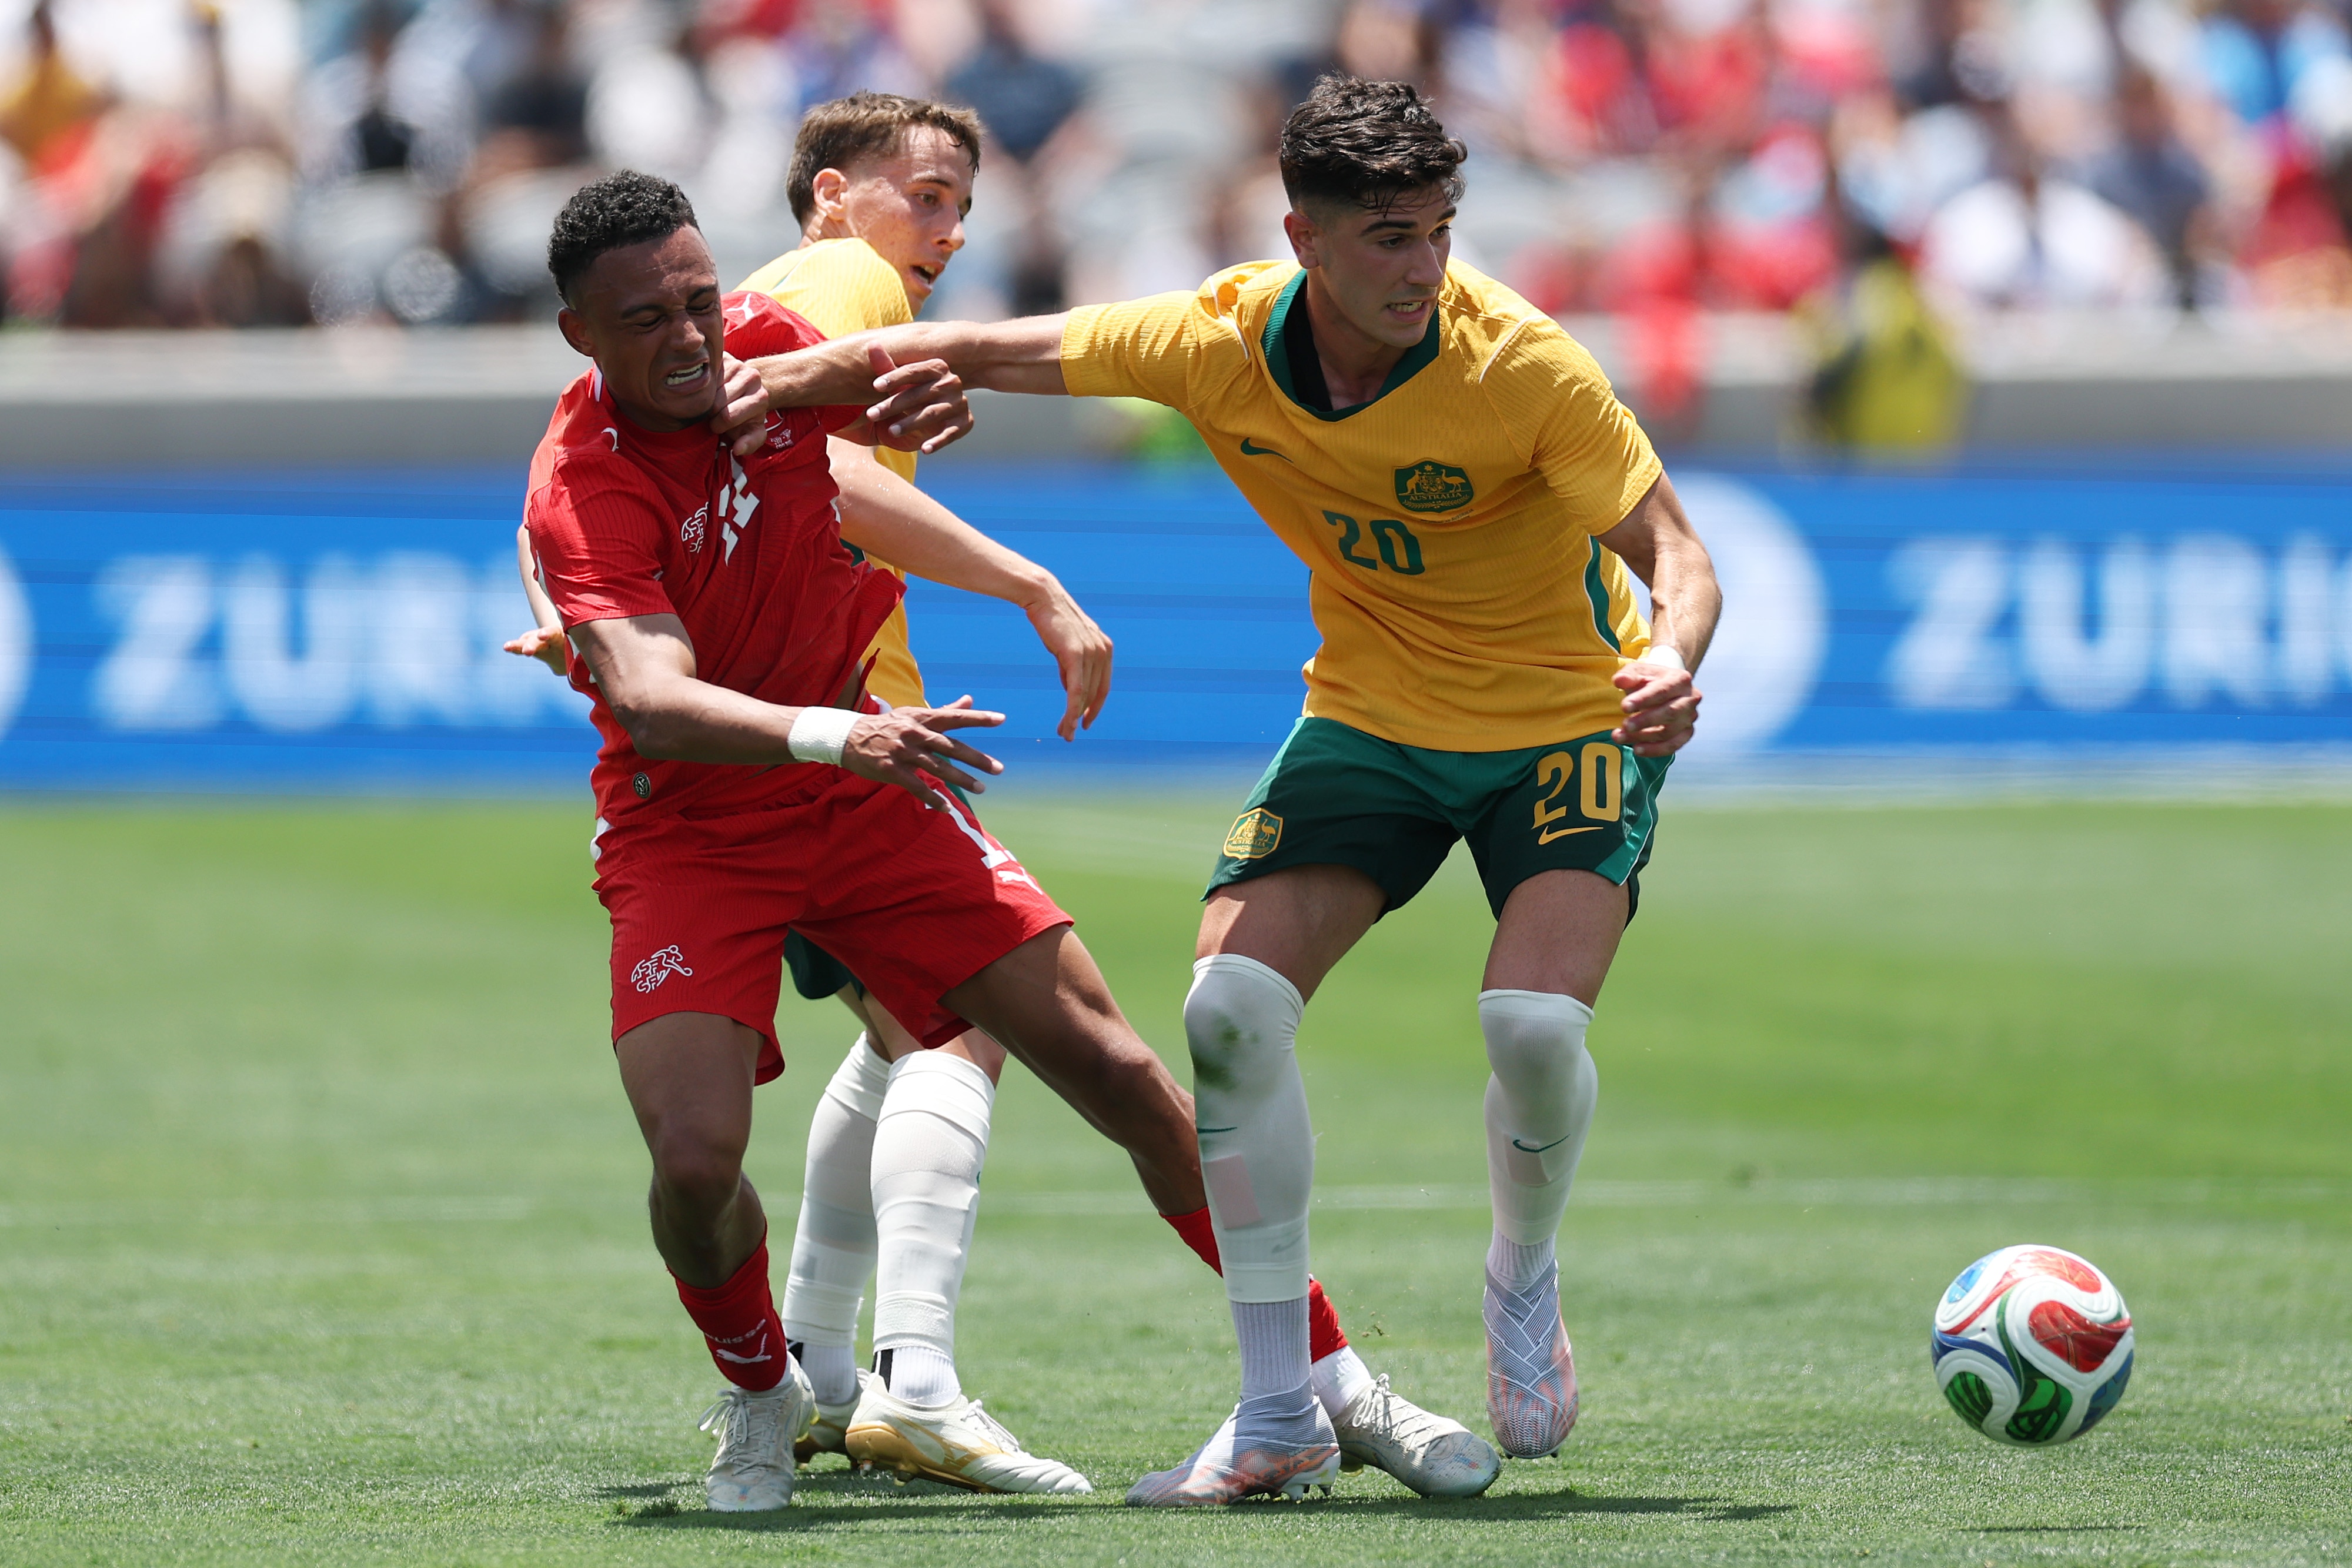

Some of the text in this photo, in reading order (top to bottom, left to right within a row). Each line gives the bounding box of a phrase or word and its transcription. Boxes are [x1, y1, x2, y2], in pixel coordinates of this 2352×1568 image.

[1409, 492, 1462, 500] AUSTRALIA
[1322, 510, 1425, 576] 20
[94, 551, 593, 731] ZURI
[1882, 533, 2352, 709] ZURI
[1531, 743, 1622, 830] 20
